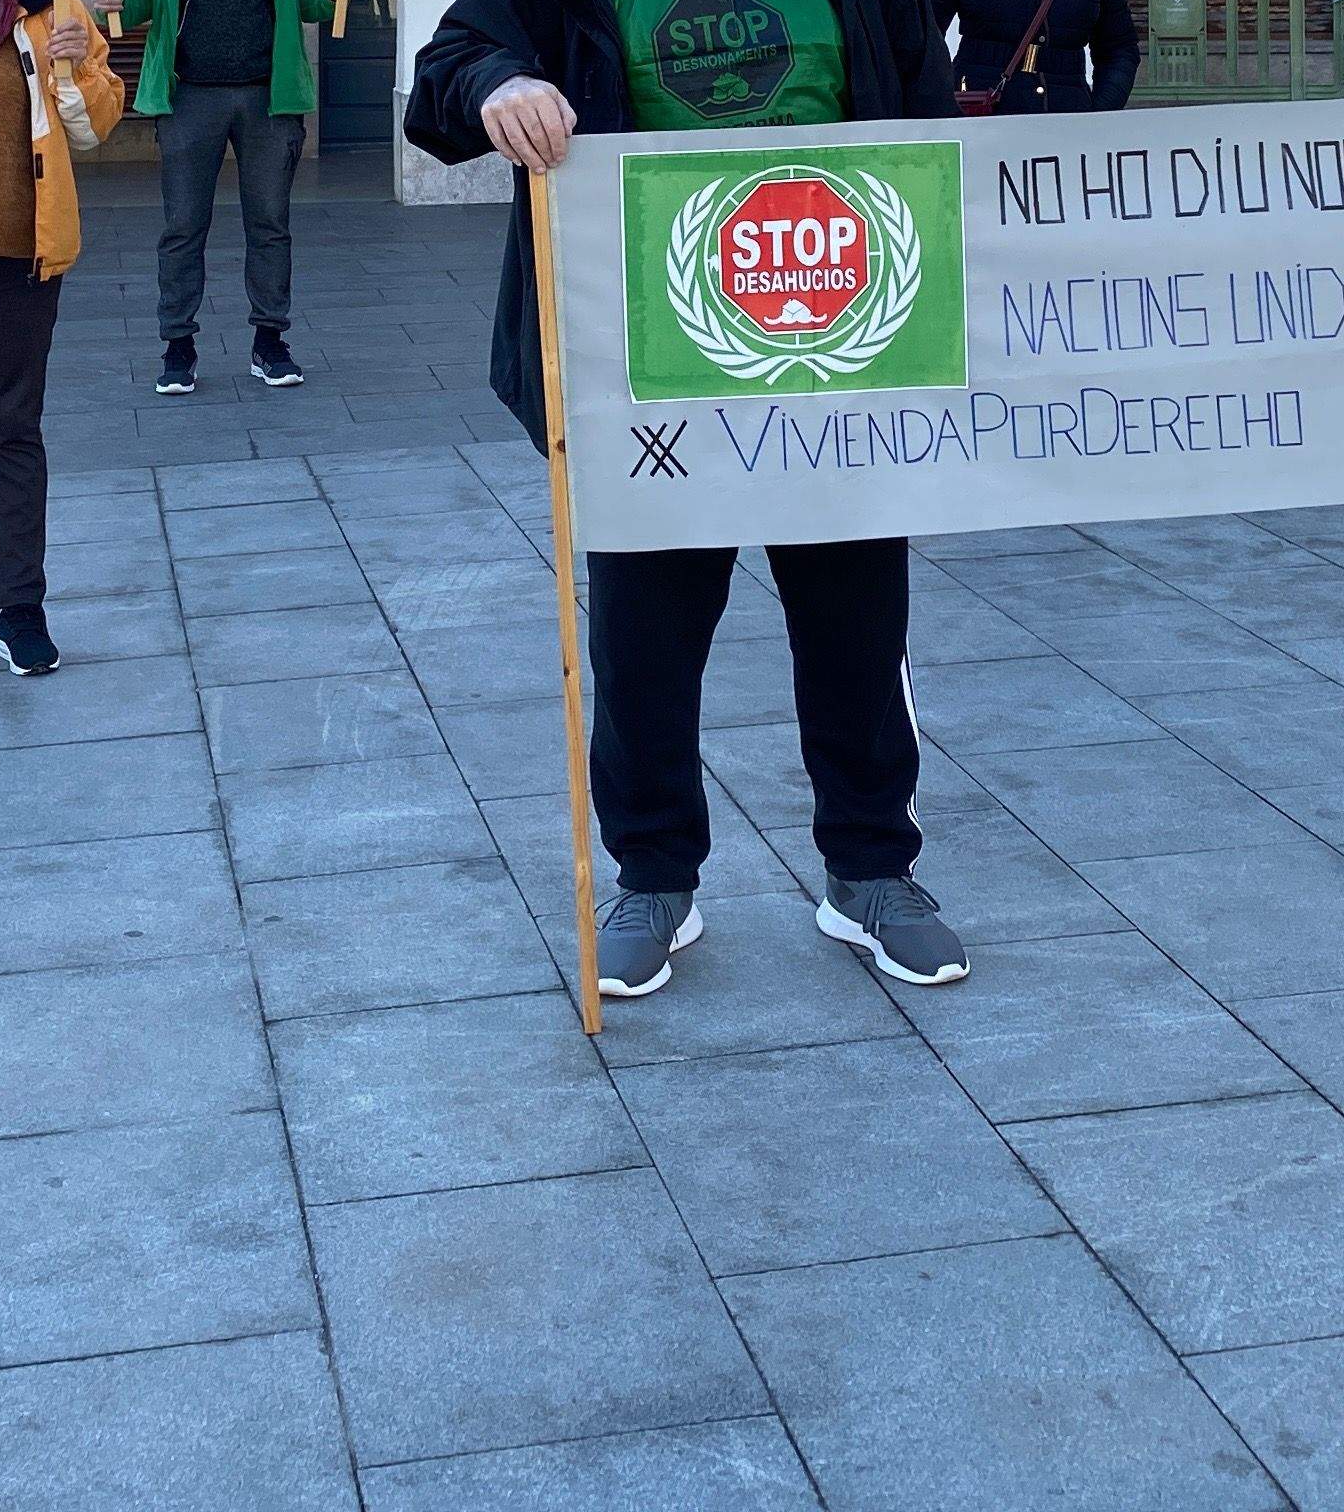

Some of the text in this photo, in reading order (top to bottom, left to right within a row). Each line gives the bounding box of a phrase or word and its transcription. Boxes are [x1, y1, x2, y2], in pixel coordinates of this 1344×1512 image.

[669, 9, 769, 56] STOP
[673, 43, 777, 74] DESNONAMENTS
[999, 156, 1065, 225] NO
[1081, 150, 1152, 220] HO
[731, 216, 857, 269] STOP
[733, 267, 856, 295] DESAHUCIOS
